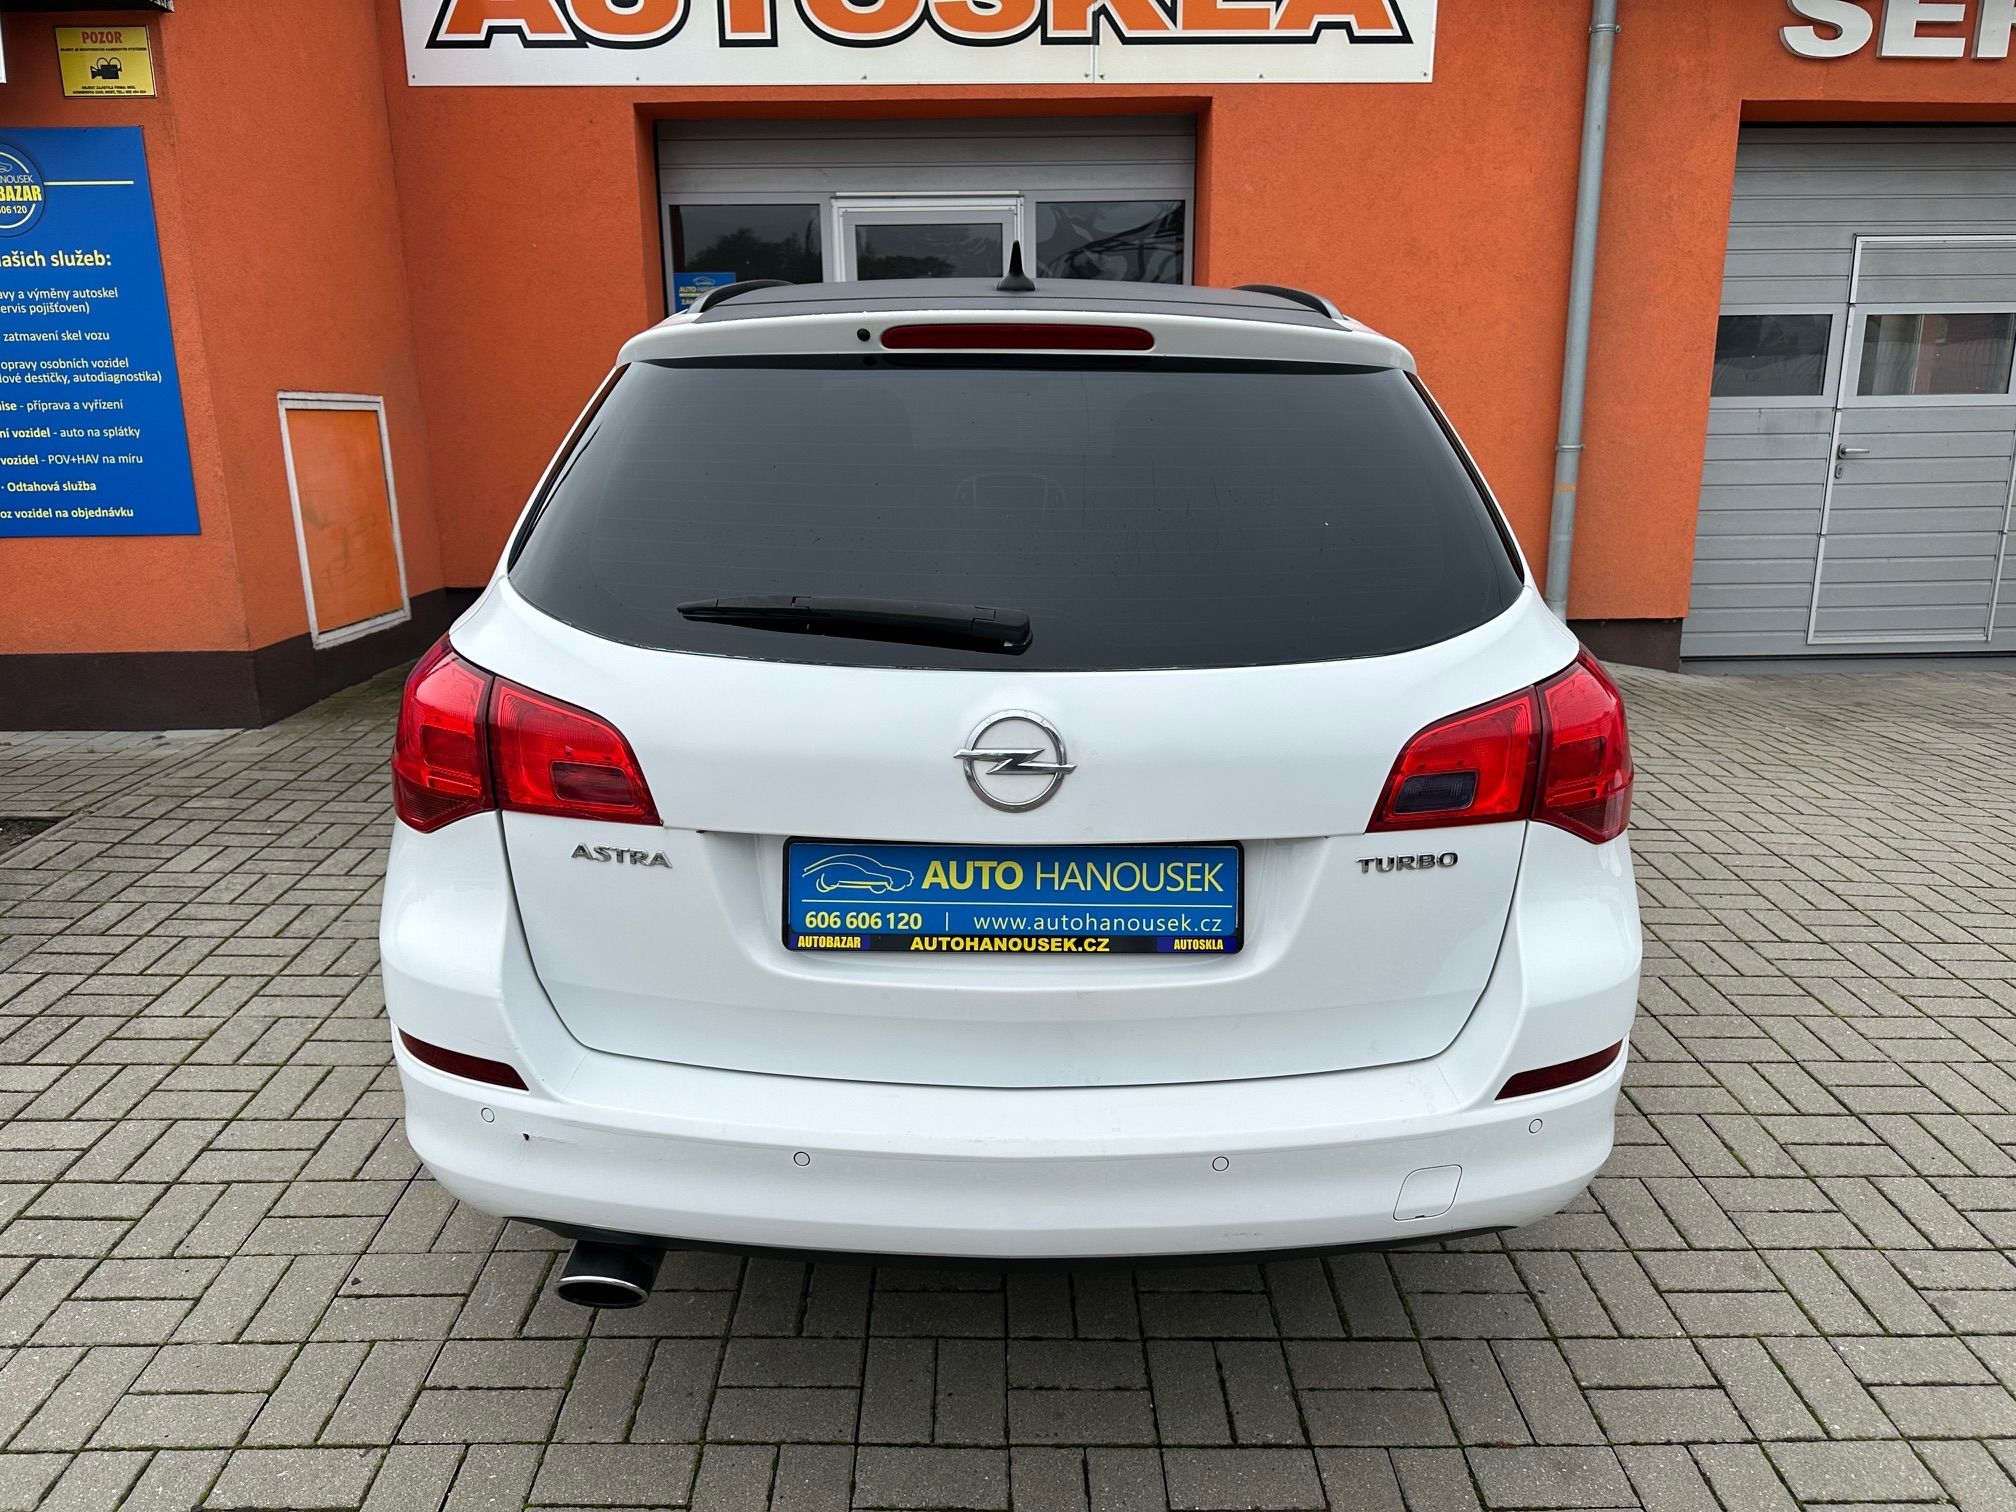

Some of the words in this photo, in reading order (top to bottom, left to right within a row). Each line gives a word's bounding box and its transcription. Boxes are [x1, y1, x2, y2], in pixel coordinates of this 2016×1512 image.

[81, 31, 123, 44] POZOR
[0, 174, 34, 184] NOUSEK
[0, 205, 12, 214] 06
[12, 205, 28, 214] 120
[51, 250, 112, 266] služeb:
[18, 291, 25, 299] a
[27, 287, 69, 301] výměny
[73, 287, 118, 298] autoskel
[30, 302, 90, 315] pojišťoven)
[3, 330, 59, 341] zatmavení
[61, 329, 82, 340] skel
[85, 331, 110, 340] vozu
[1, 359, 37, 371] opravy
[40, 358, 88, 369] osobních
[91, 357, 128, 368] vozidel
[24, 372, 70, 384] destičky,
[73, 371, 162, 384] autodiagnostika)
[27, 401, 70, 412] příprava
[82, 399, 123, 412] vyřízení
[12, 427, 51, 438] vozidel
[60, 428, 84, 437] auto
[88, 429, 100, 437] na
[103, 426, 140, 439] splátky
[0, 454, 39, 465] vozidel
[48, 455, 99, 464] POV+HAV
[102, 456, 115, 464] na
[118, 453, 143, 464] míru
[7, 481, 60, 492] Odtahová
[62, 481, 96, 491] služba
[15, 508, 52, 519] vozidel
[55, 510, 69, 518] na
[71, 506, 134, 520] objednávku
[571, 842, 673, 869] ASTRA
[1356, 852, 1459, 874] TURBO
[921, 860, 1024, 891] AUTO
[1035, 861, 1225, 893] HANOUSEK
[804, 911, 841, 930] 606
[845, 911, 882, 930] 606
[886, 912, 923, 930] 120
[973, 914, 1223, 933] www.autohanousek.cz
[797, 935, 862, 949] AUTOBAZAR
[910, 937, 1111, 953] AUTOHANOUSEK.CZ
[1173, 938, 1225, 951] AUTOSKLA
